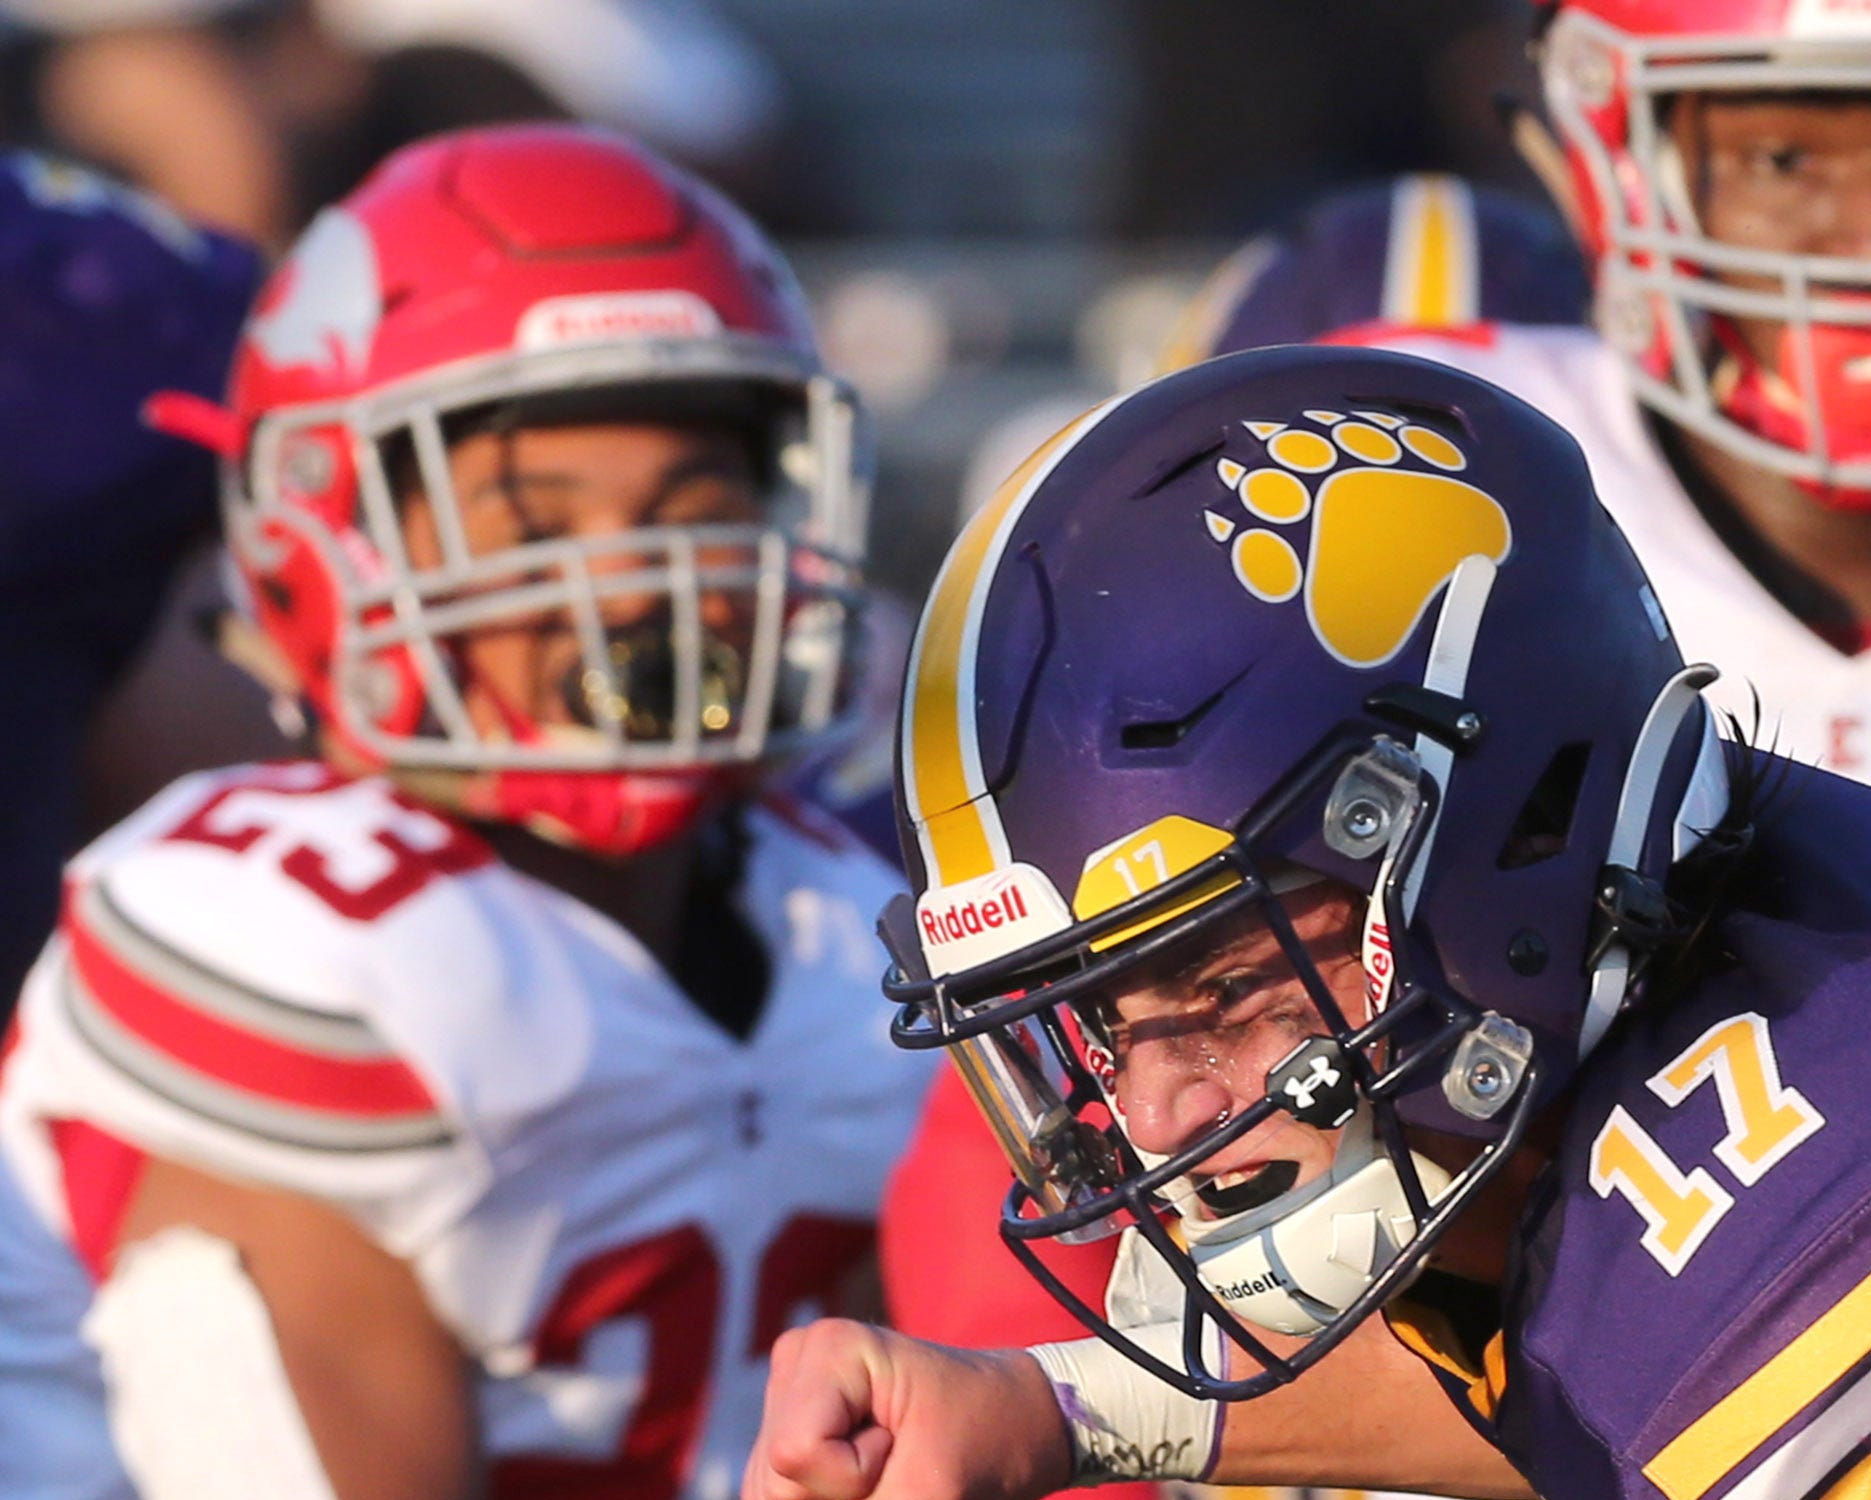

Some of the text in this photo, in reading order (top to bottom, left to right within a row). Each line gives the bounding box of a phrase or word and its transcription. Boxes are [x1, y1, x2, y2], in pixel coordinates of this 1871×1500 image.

[1113, 839, 1171, 898] 17
[920, 884, 1029, 946] Riddell
[1588, 1011, 1826, 1277] 17
